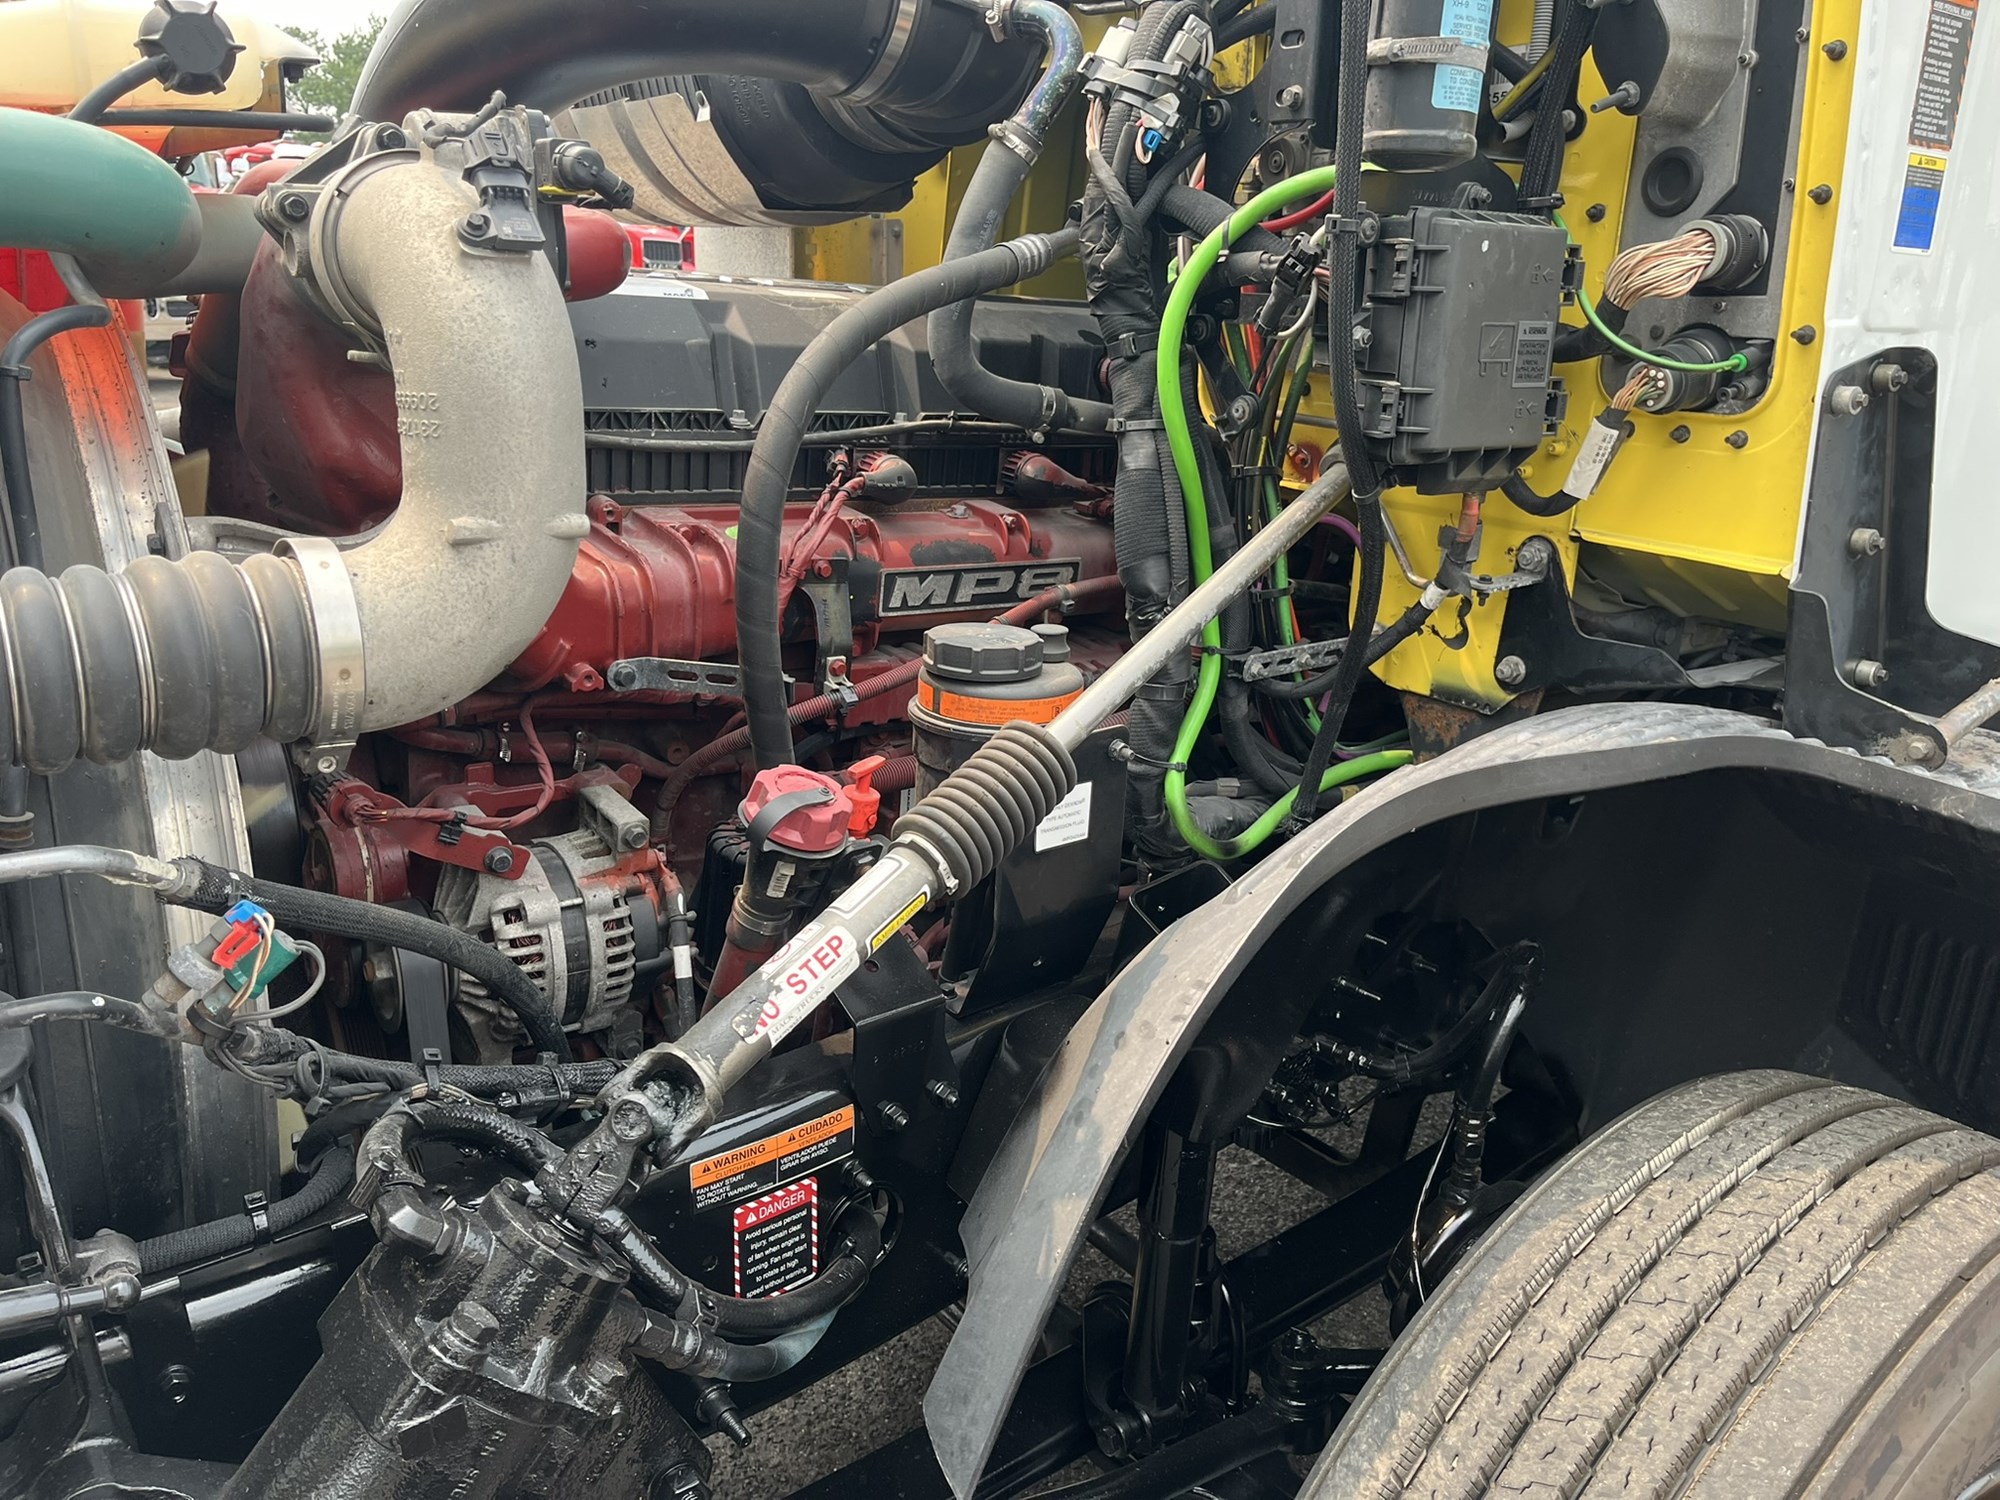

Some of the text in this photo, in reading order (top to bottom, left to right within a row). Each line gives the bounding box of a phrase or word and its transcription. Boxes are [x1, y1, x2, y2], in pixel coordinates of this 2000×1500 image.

[888, 566, 1074, 609] MP8
[786, 935, 843, 995] STEP
[797, 985, 826, 1015] TRUCKS
[798, 1112, 843, 1138] CUIDADO
[713, 1143, 766, 1170] WARNING
[780, 1137, 837, 1165] VENTILADOR PUEDE
[780, 1159, 799, 1172] GIRAR
[800, 1154, 811, 1164] SIN
[715, 1160, 756, 1179] CLUTCH FAN
[696, 1183, 710, 1195] FAN
[710, 1180, 724, 1192] MAY
[724, 1173, 745, 1187] START
[696, 1185, 731, 1202] TO ROTATE
[696, 1194, 726, 1209] WITHOUT
[759, 1190, 805, 1219] DANGER
[744, 1209, 807, 1241] Avoid serious personal
[768, 1230, 788, 1244] remain
[789, 1223, 803, 1236] clear
[747, 1232, 805, 1264] of fan when engine is
[770, 1256, 781, 1268] Fan
[781, 1249, 794, 1264] may
[794, 1243, 808, 1256] start
[756, 1258, 799, 1282] to rotate at high
[746, 1285, 764, 1299] speed
[764, 1274, 785, 1290] without
